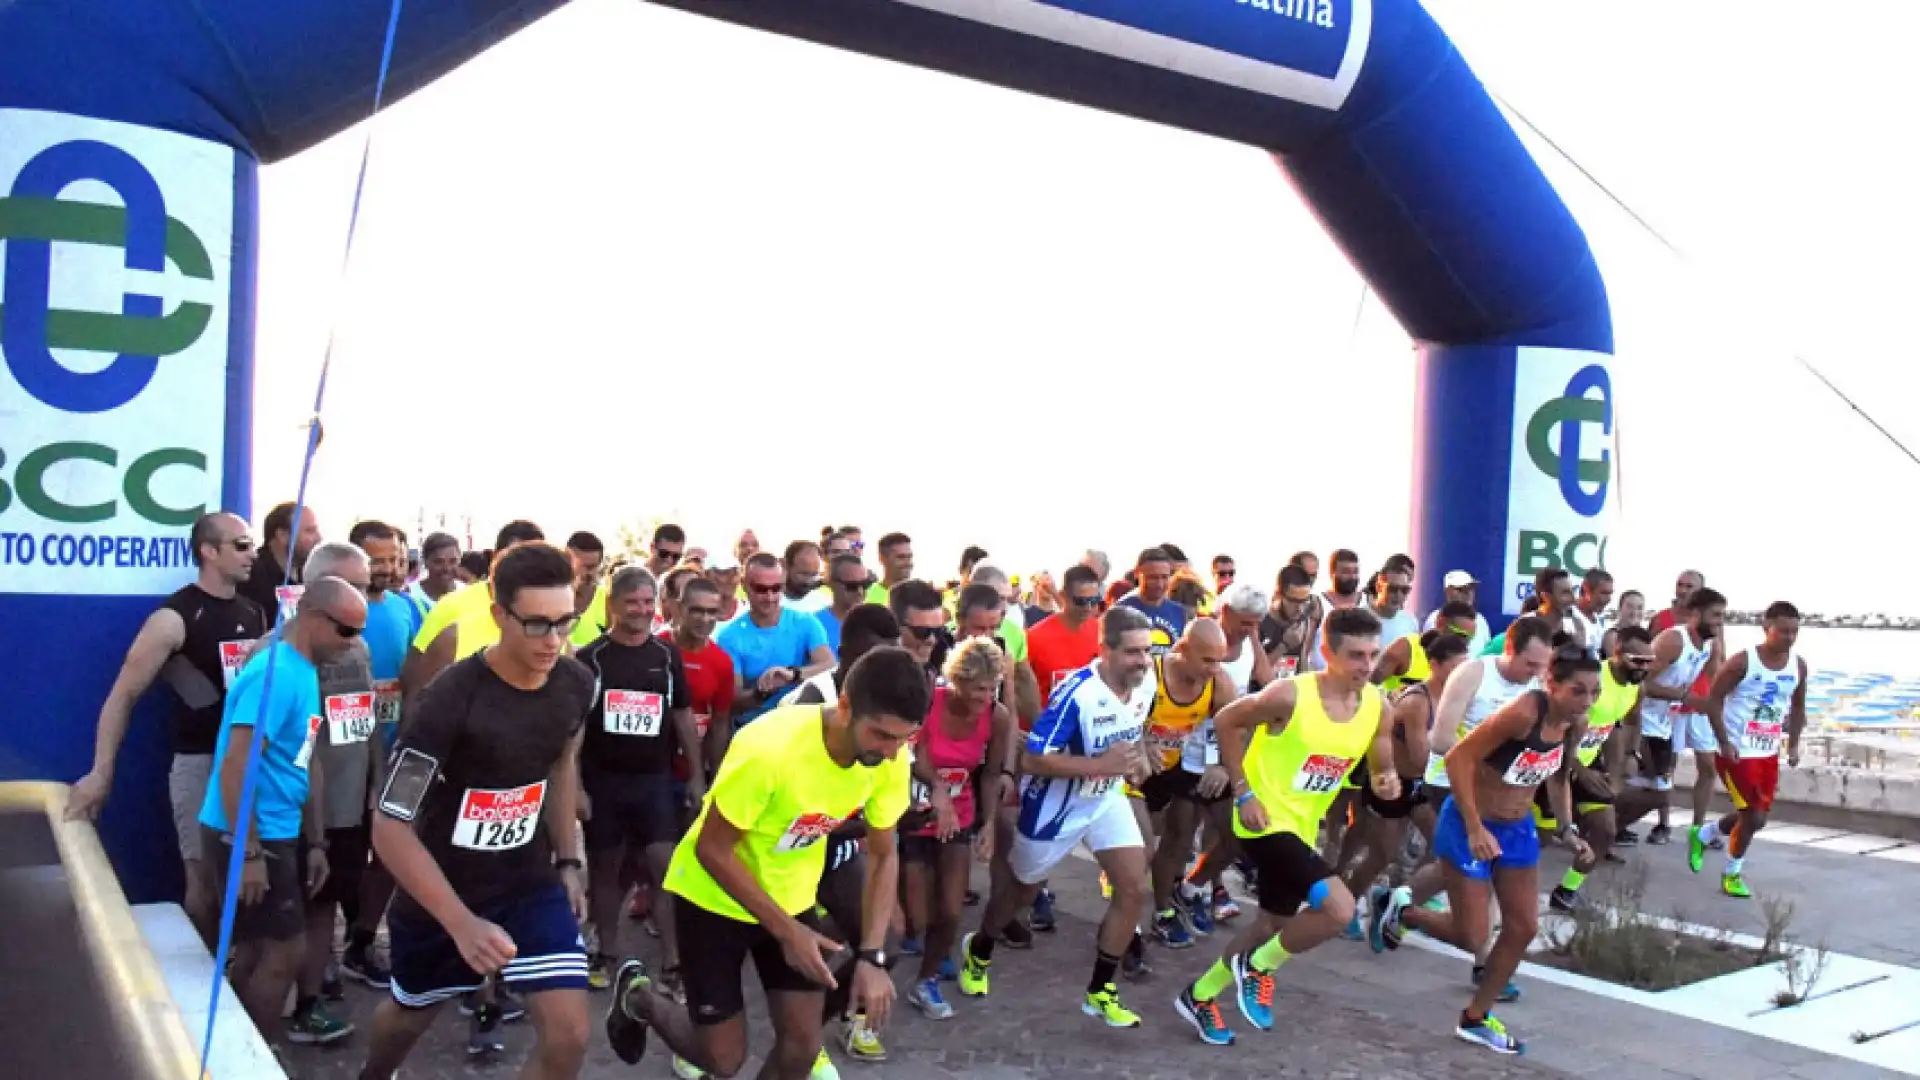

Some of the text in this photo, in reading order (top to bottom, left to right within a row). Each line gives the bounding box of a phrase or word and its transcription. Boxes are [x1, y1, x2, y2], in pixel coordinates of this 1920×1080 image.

[0, 440, 207, 526] CC
[1517, 530, 1607, 577] BC
[615, 713, 654, 732] 1479
[493, 787, 525, 807] new
[473, 817, 528, 846] 1265
